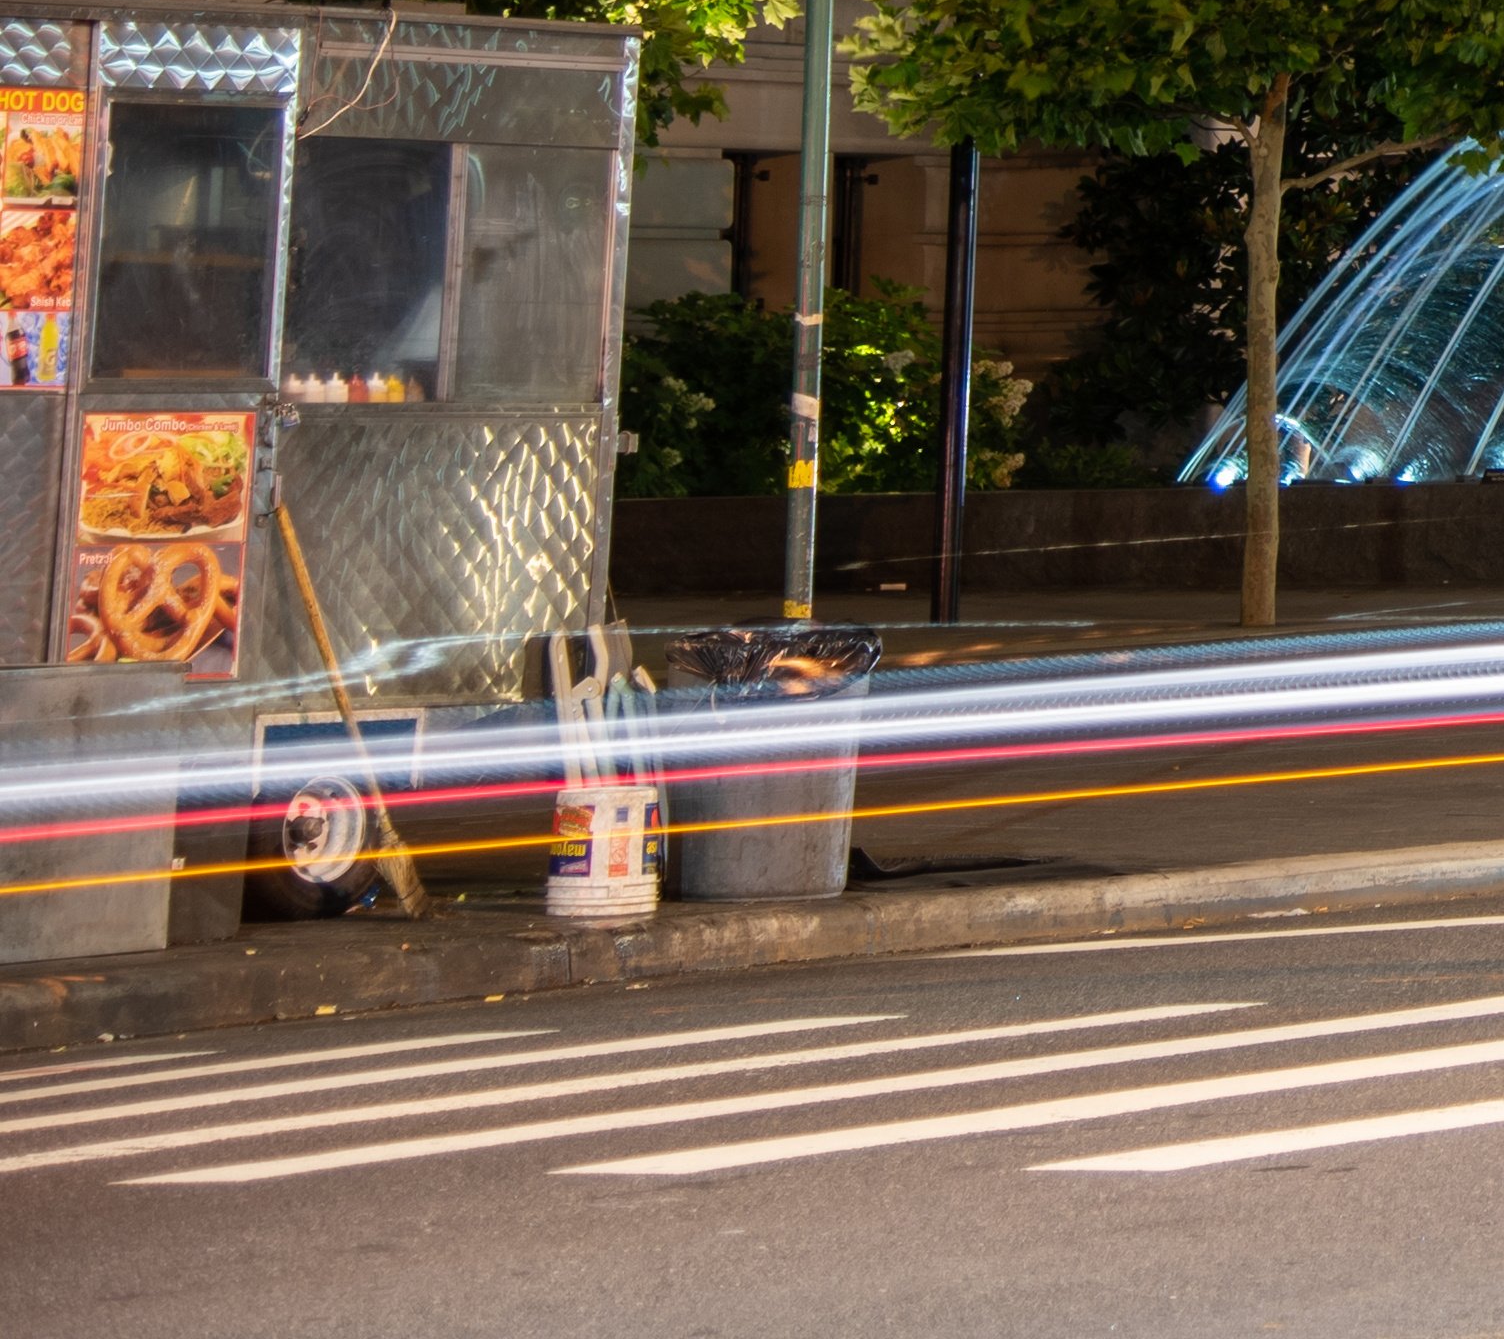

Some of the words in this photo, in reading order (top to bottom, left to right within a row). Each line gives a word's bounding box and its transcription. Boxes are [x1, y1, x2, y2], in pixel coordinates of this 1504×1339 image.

[0, 90, 37, 111] HOT
[42, 91, 85, 113] DOG
[31, 296, 55, 307] Shish
[102, 418, 141, 432] Jumbo
[145, 417, 187, 431] Combo
